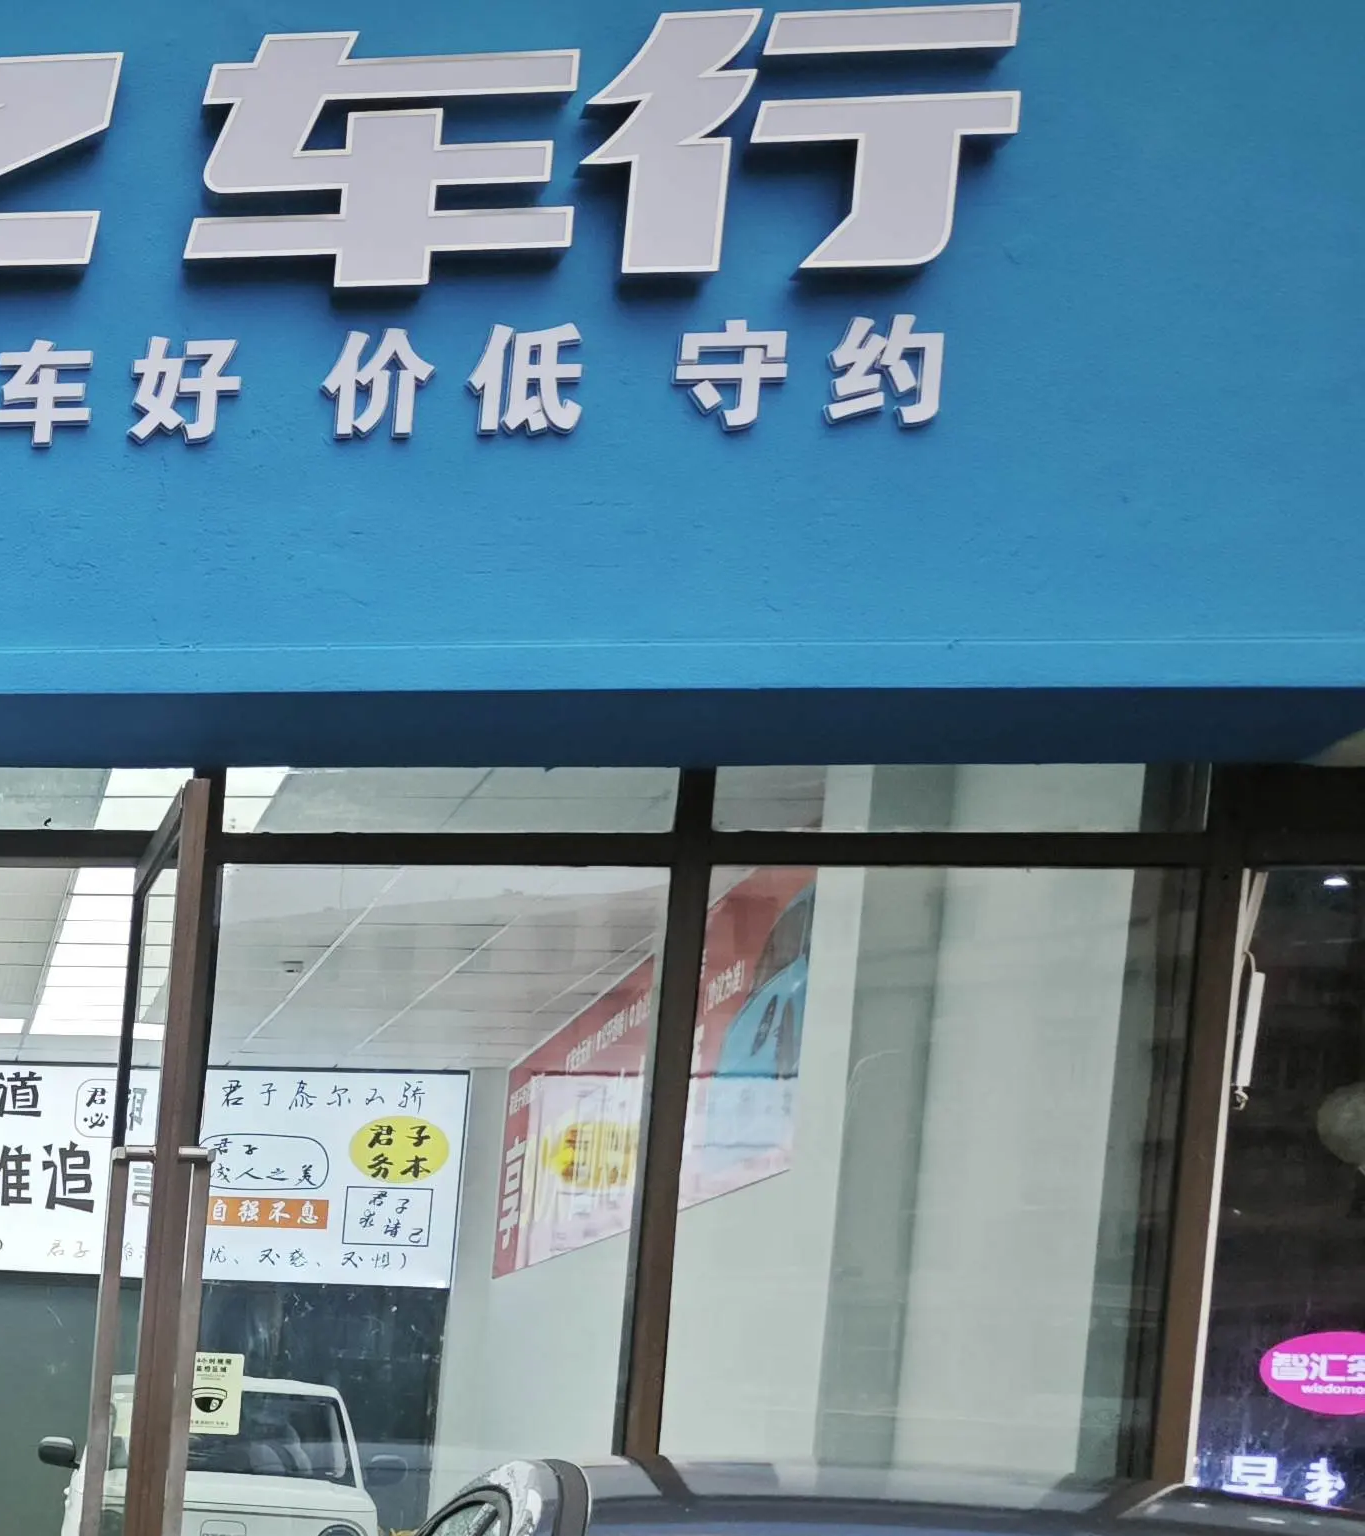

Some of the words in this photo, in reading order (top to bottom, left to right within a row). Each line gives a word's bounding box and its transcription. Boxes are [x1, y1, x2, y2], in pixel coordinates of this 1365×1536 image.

[322, 322, 583, 439] 价低
[675, 313, 945, 430] 守约
[213, 1138, 258, 1155] 君子
[368, 1125, 431, 1148] 君子
[367, 1153, 431, 1179] 务本
[212, 1200, 319, 1225] 自强不息
